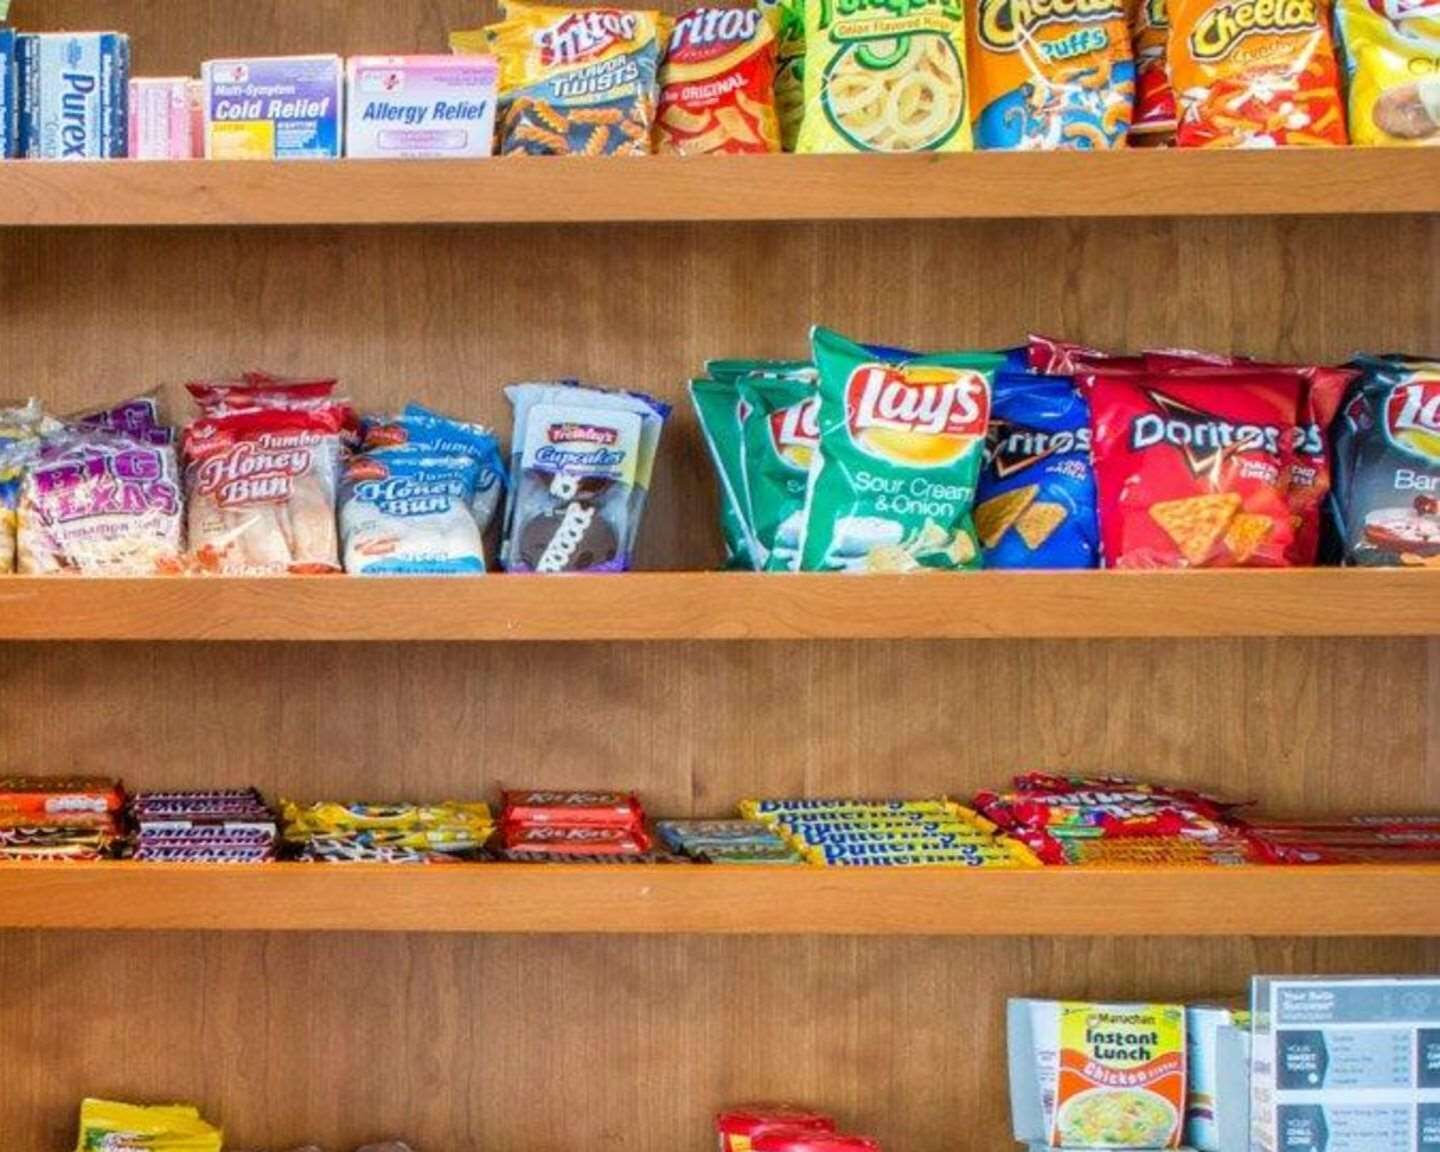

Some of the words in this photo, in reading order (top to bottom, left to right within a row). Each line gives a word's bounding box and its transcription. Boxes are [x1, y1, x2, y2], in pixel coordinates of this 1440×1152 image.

[670, 7, 764, 51] ritos
[62, 73, 96, 158] Purex
[215, 99, 262, 120] Cold
[267, 97, 330, 119] Relief
[362, 101, 428, 125] Allergy
[431, 100, 488, 121] Relief
[857, 368, 984, 432] Lay's
[260, 431, 323, 451] Jumbo
[1007, 427, 1092, 456] ritos
[1132, 413, 1279, 453] Doritos
[202, 445, 312, 487] Honey
[221, 475, 294, 503] Bun
[356, 478, 463, 501] Honey
[855, 472, 905, 493] Sour
[910, 476, 975, 501] Cream
[382, 496, 451, 517] Bun
[892, 494, 955, 517] Onion
[1086, 1028, 1159, 1047] Instant
[1094, 1046, 1152, 1061] Lunch
